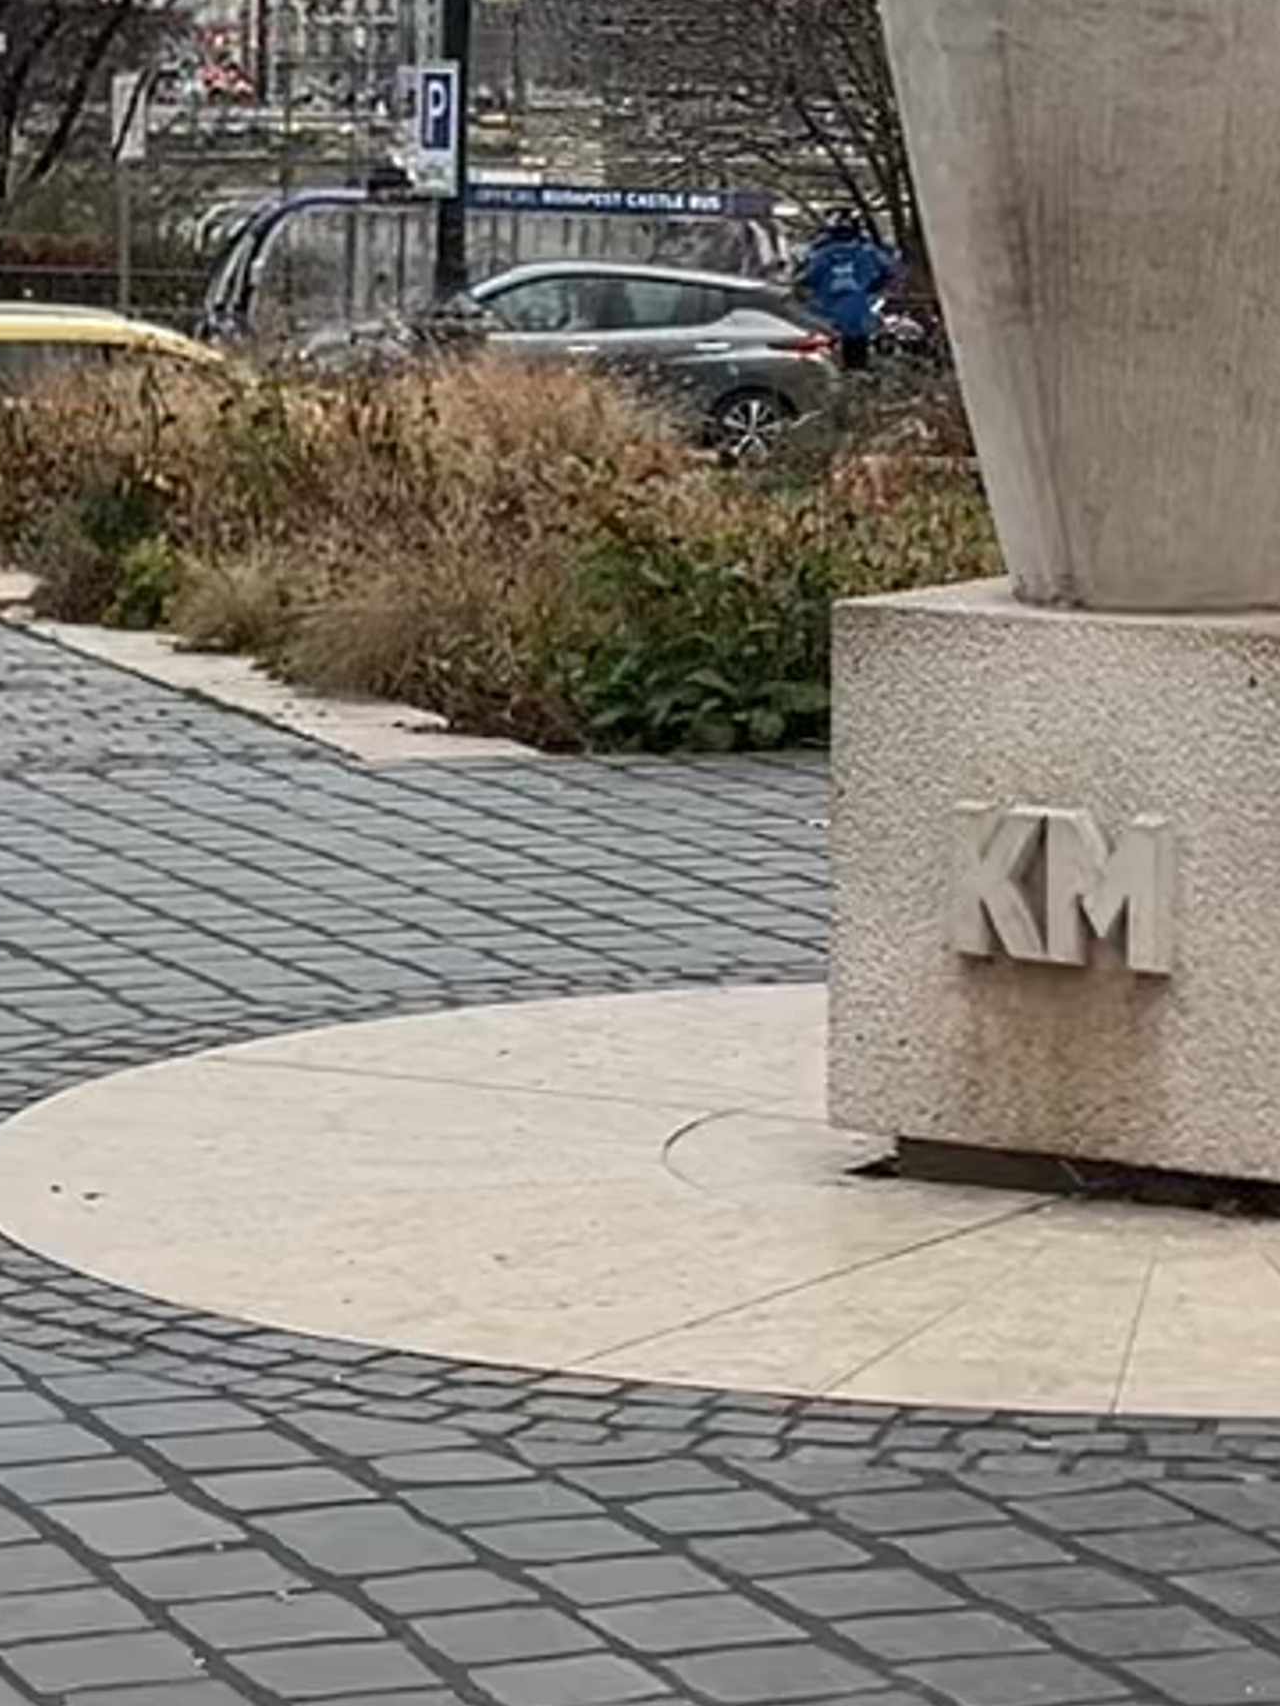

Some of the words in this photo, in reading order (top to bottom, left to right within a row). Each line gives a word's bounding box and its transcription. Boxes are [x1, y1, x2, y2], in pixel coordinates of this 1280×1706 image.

[427, 80, 447, 144] P
[541, 188, 621, 206] BUDAPEST
[626, 191, 684, 209] CASTLE
[688, 194, 721, 210] BUS
[956, 800, 1172, 975] KM
